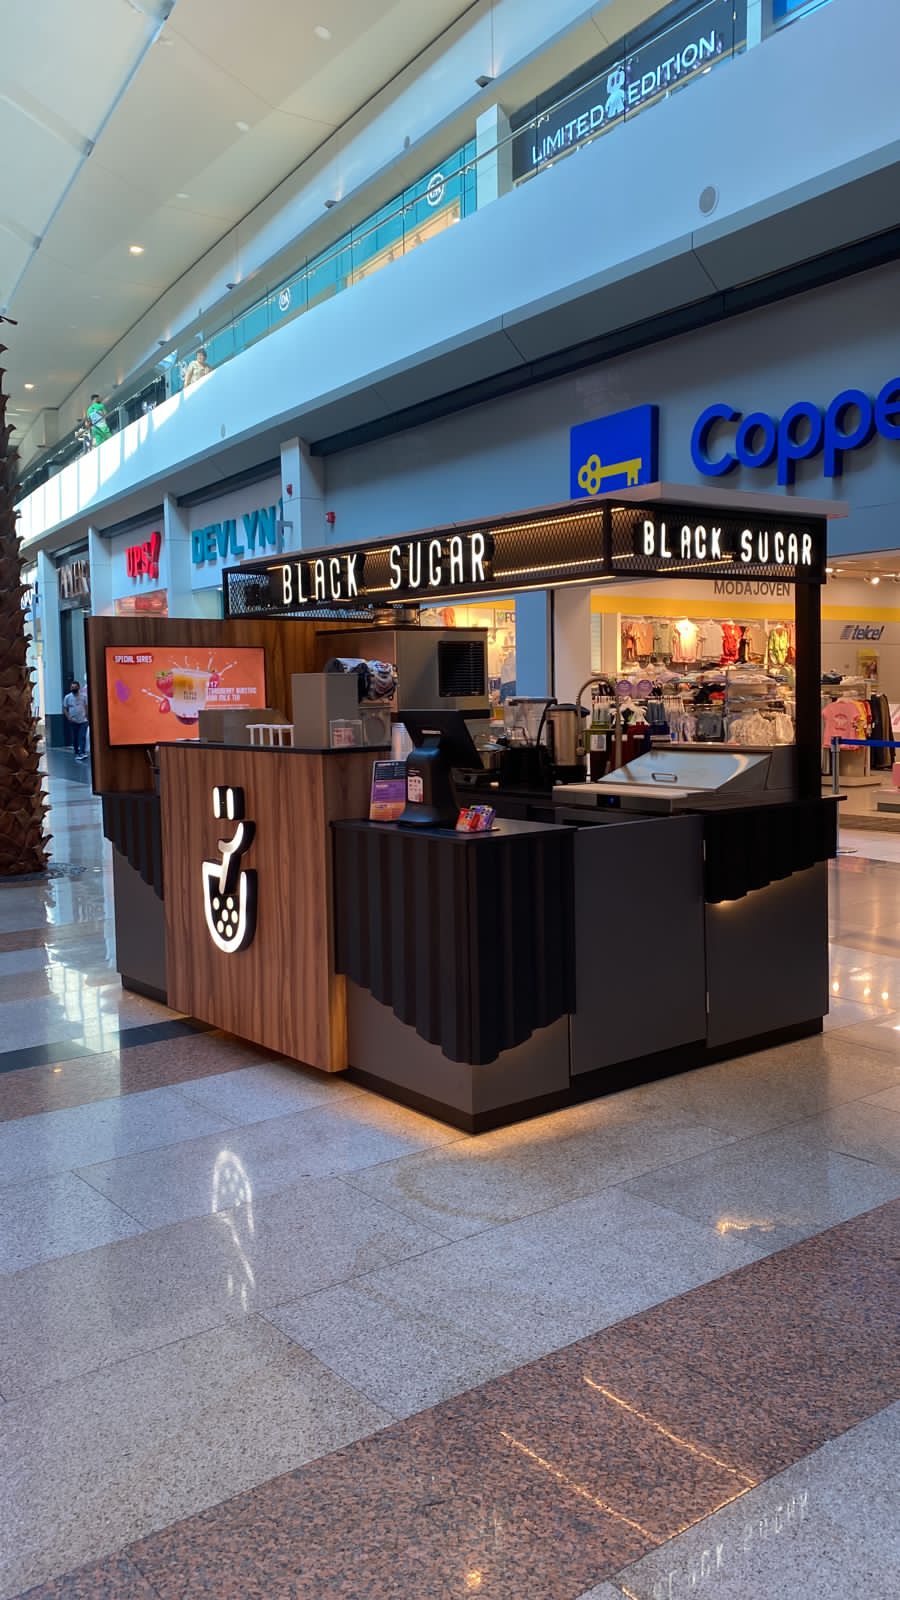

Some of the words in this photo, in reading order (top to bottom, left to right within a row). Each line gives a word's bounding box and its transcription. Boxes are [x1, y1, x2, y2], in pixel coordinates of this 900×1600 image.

[532, 105, 604, 164] LIMITED
[627, 31, 715, 104] EDITION
[283, 554, 357, 604] BLACK
[389, 532, 485, 590] SUGAR
[643, 520, 722, 560] BLACK
[740, 529, 812, 565] SUGAR
[850, 624, 885, 640] telcel
